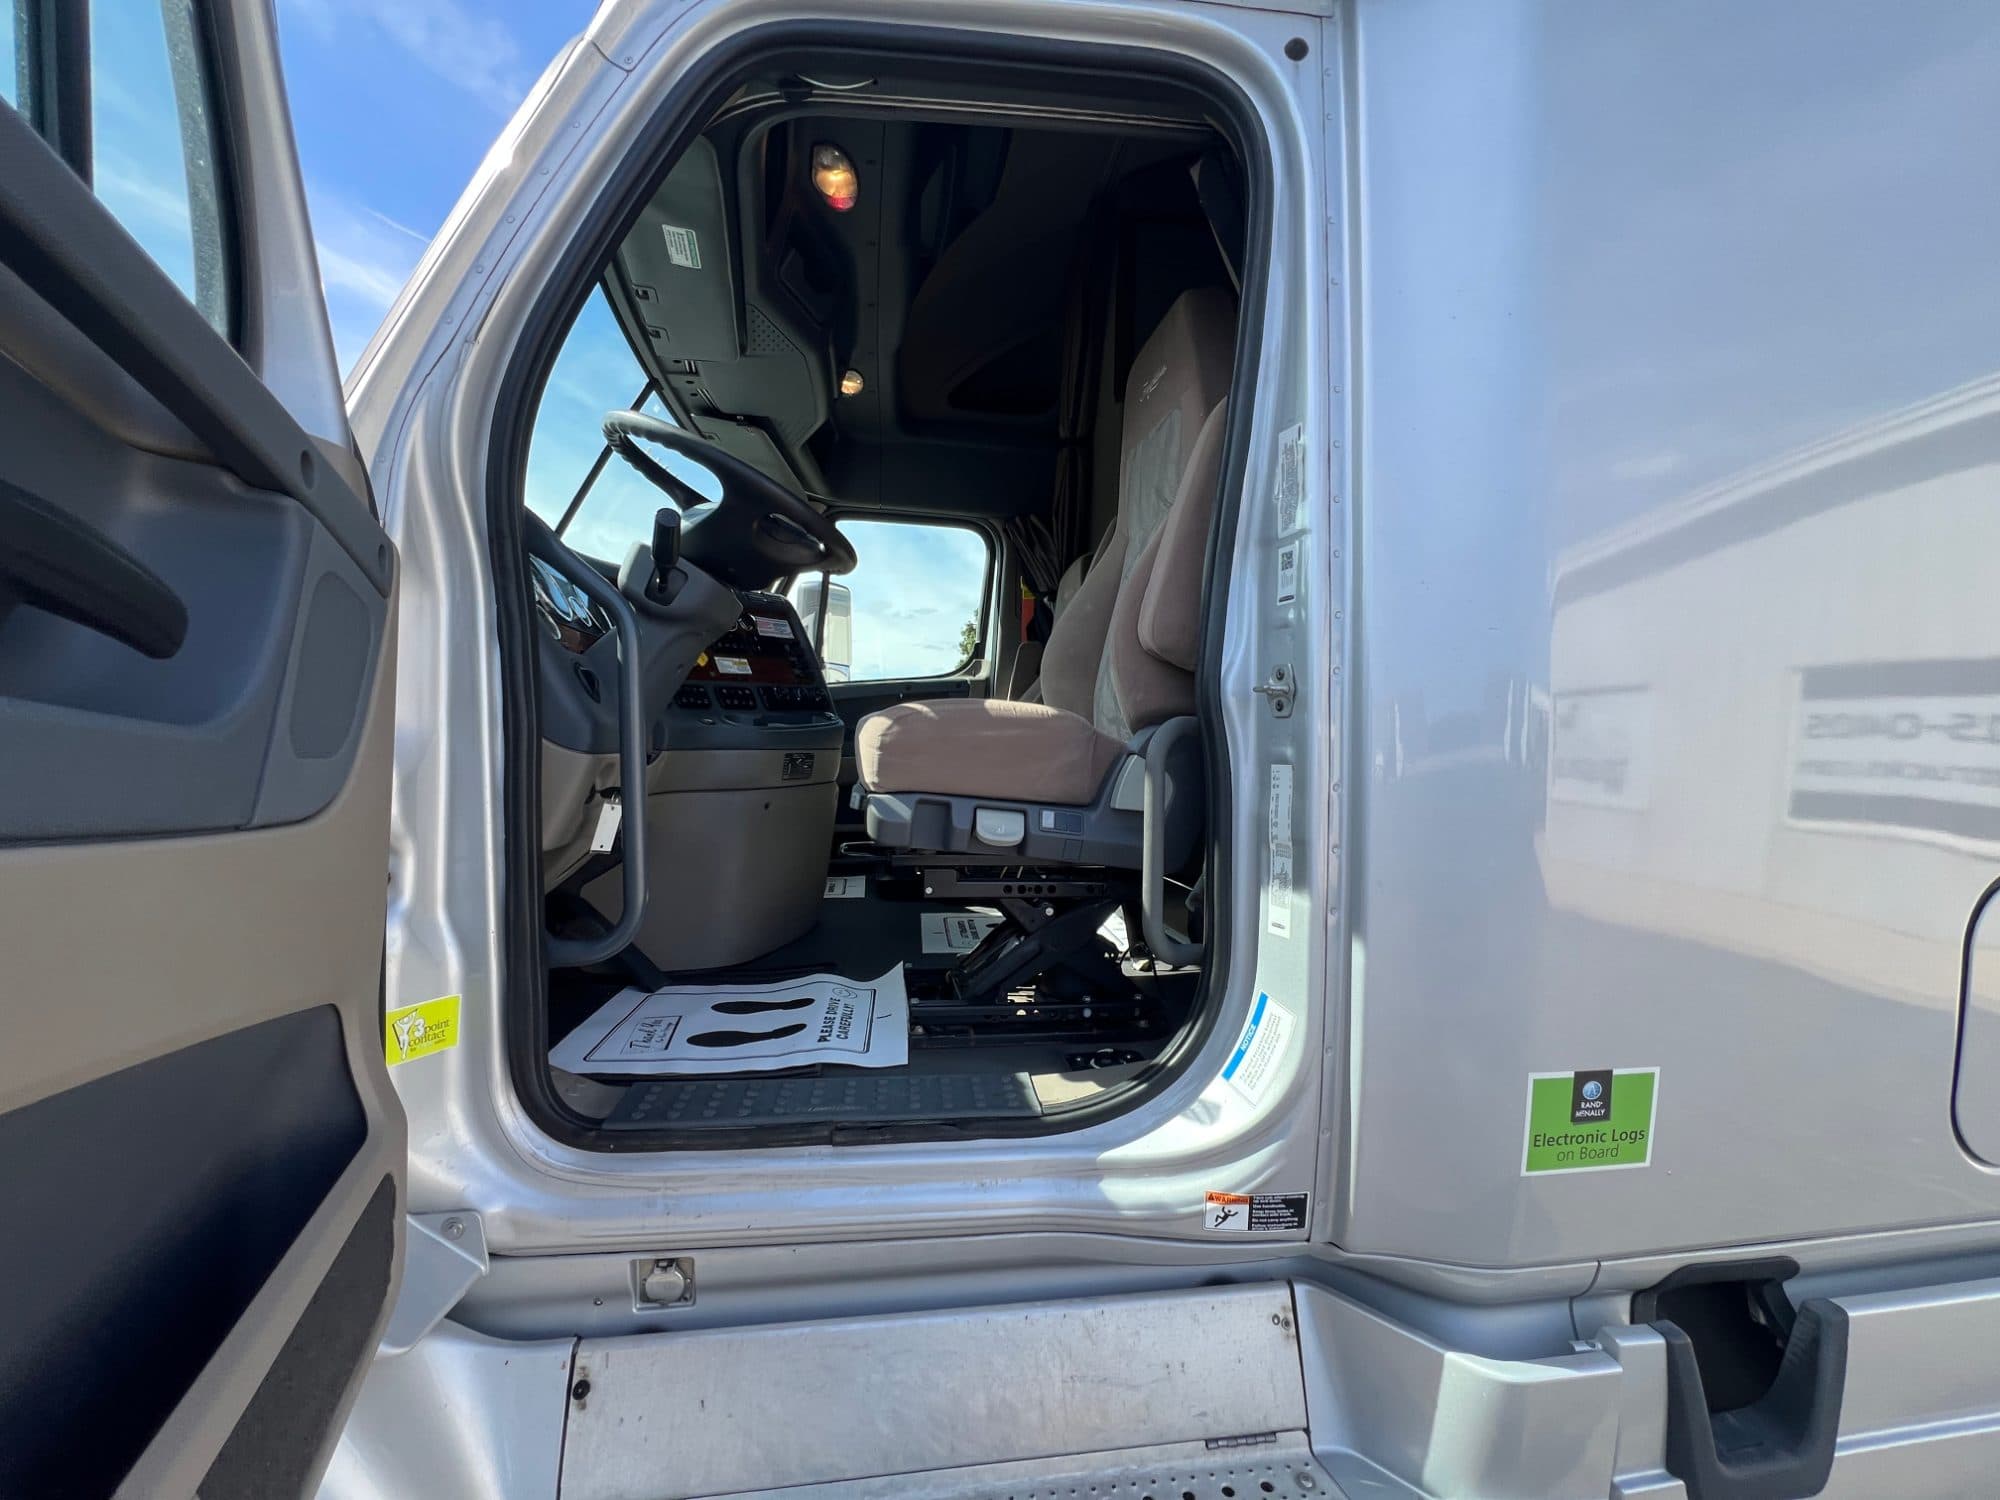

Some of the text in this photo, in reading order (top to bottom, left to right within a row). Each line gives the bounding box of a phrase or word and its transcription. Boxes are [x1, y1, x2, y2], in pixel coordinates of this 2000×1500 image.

[414, 1018, 449, 1037] 3 point
[817, 997, 841, 1042] PLEASE DRIVE
[408, 1030, 446, 1047] contact
[1240, 1023, 1256, 1051] NOTICE
[1533, 1129, 1645, 1147] Electronic Logs
[1557, 1144, 1619, 1161] on Board
